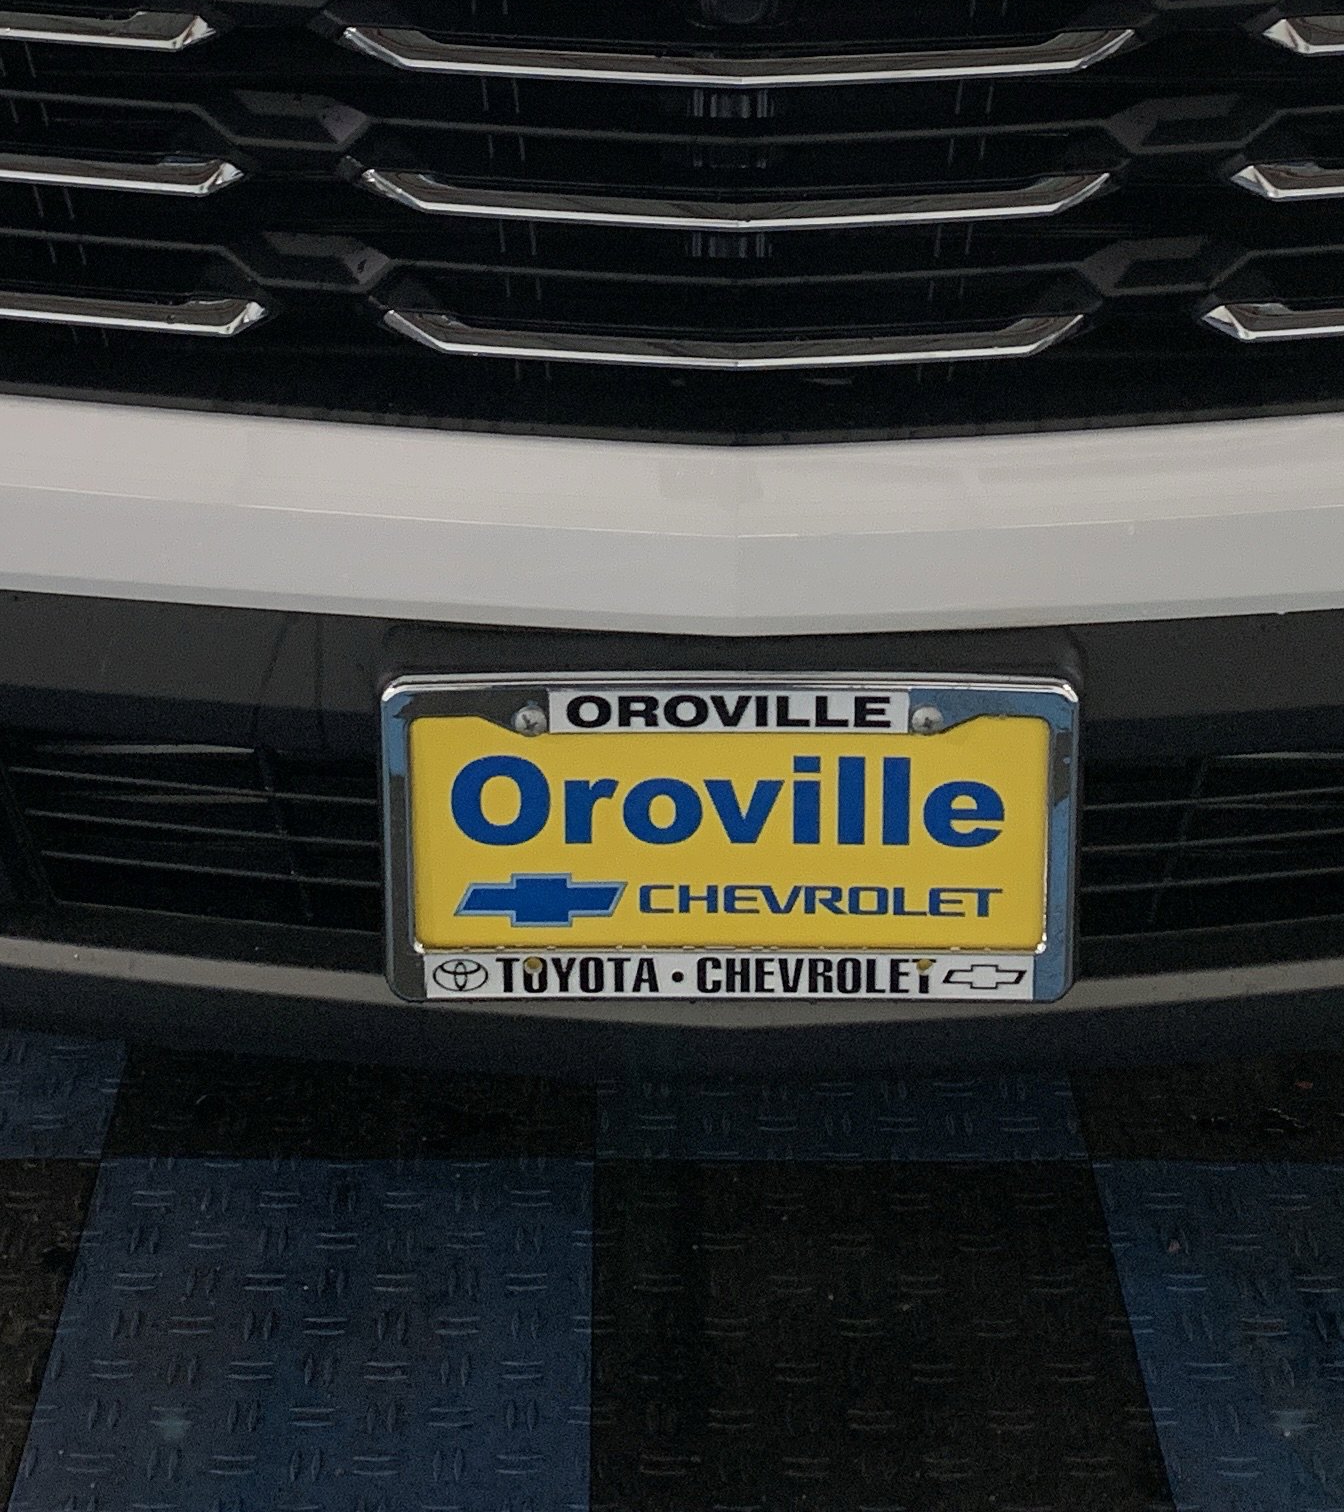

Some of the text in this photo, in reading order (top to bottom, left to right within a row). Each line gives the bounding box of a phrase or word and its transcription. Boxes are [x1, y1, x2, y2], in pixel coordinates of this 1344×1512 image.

[565, 694, 891, 729] OROVILLE
[450, 755, 1005, 848] Oroville
[638, 884, 1004, 918] CHEVROLET
[496, 957, 938, 995] TOYOTA CHEVROLET
